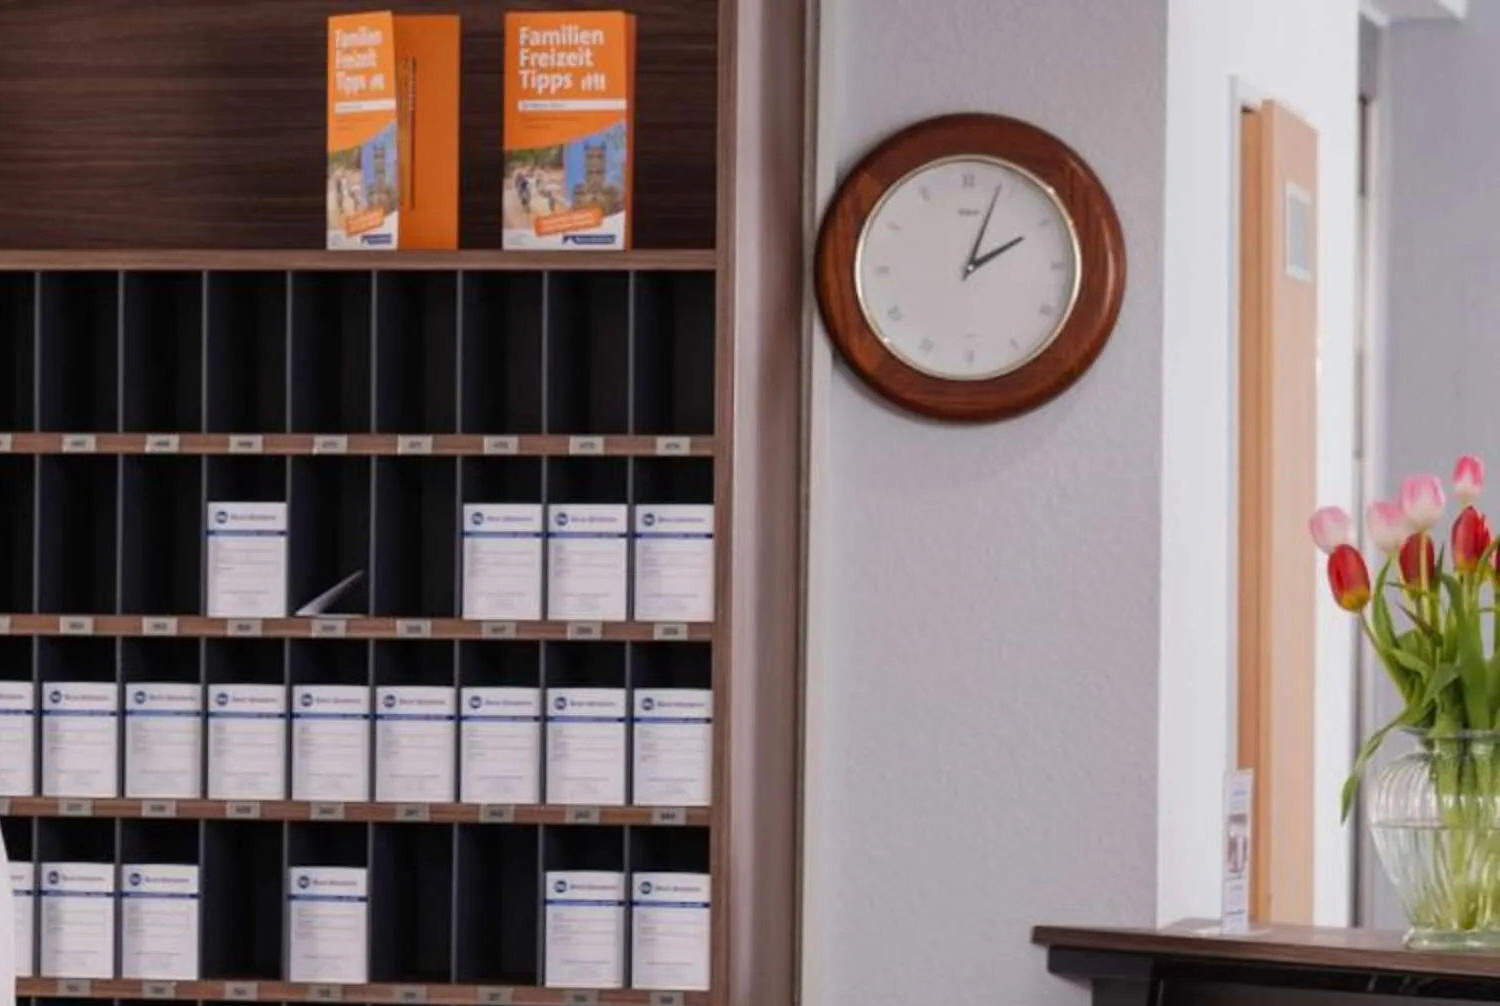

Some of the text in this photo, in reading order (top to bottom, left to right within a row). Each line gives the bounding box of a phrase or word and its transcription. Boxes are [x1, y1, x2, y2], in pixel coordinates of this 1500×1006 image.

[519, 25, 604, 46] Familien
[519, 48, 593, 68] Freizeit
[519, 69, 573, 94] Tipps
